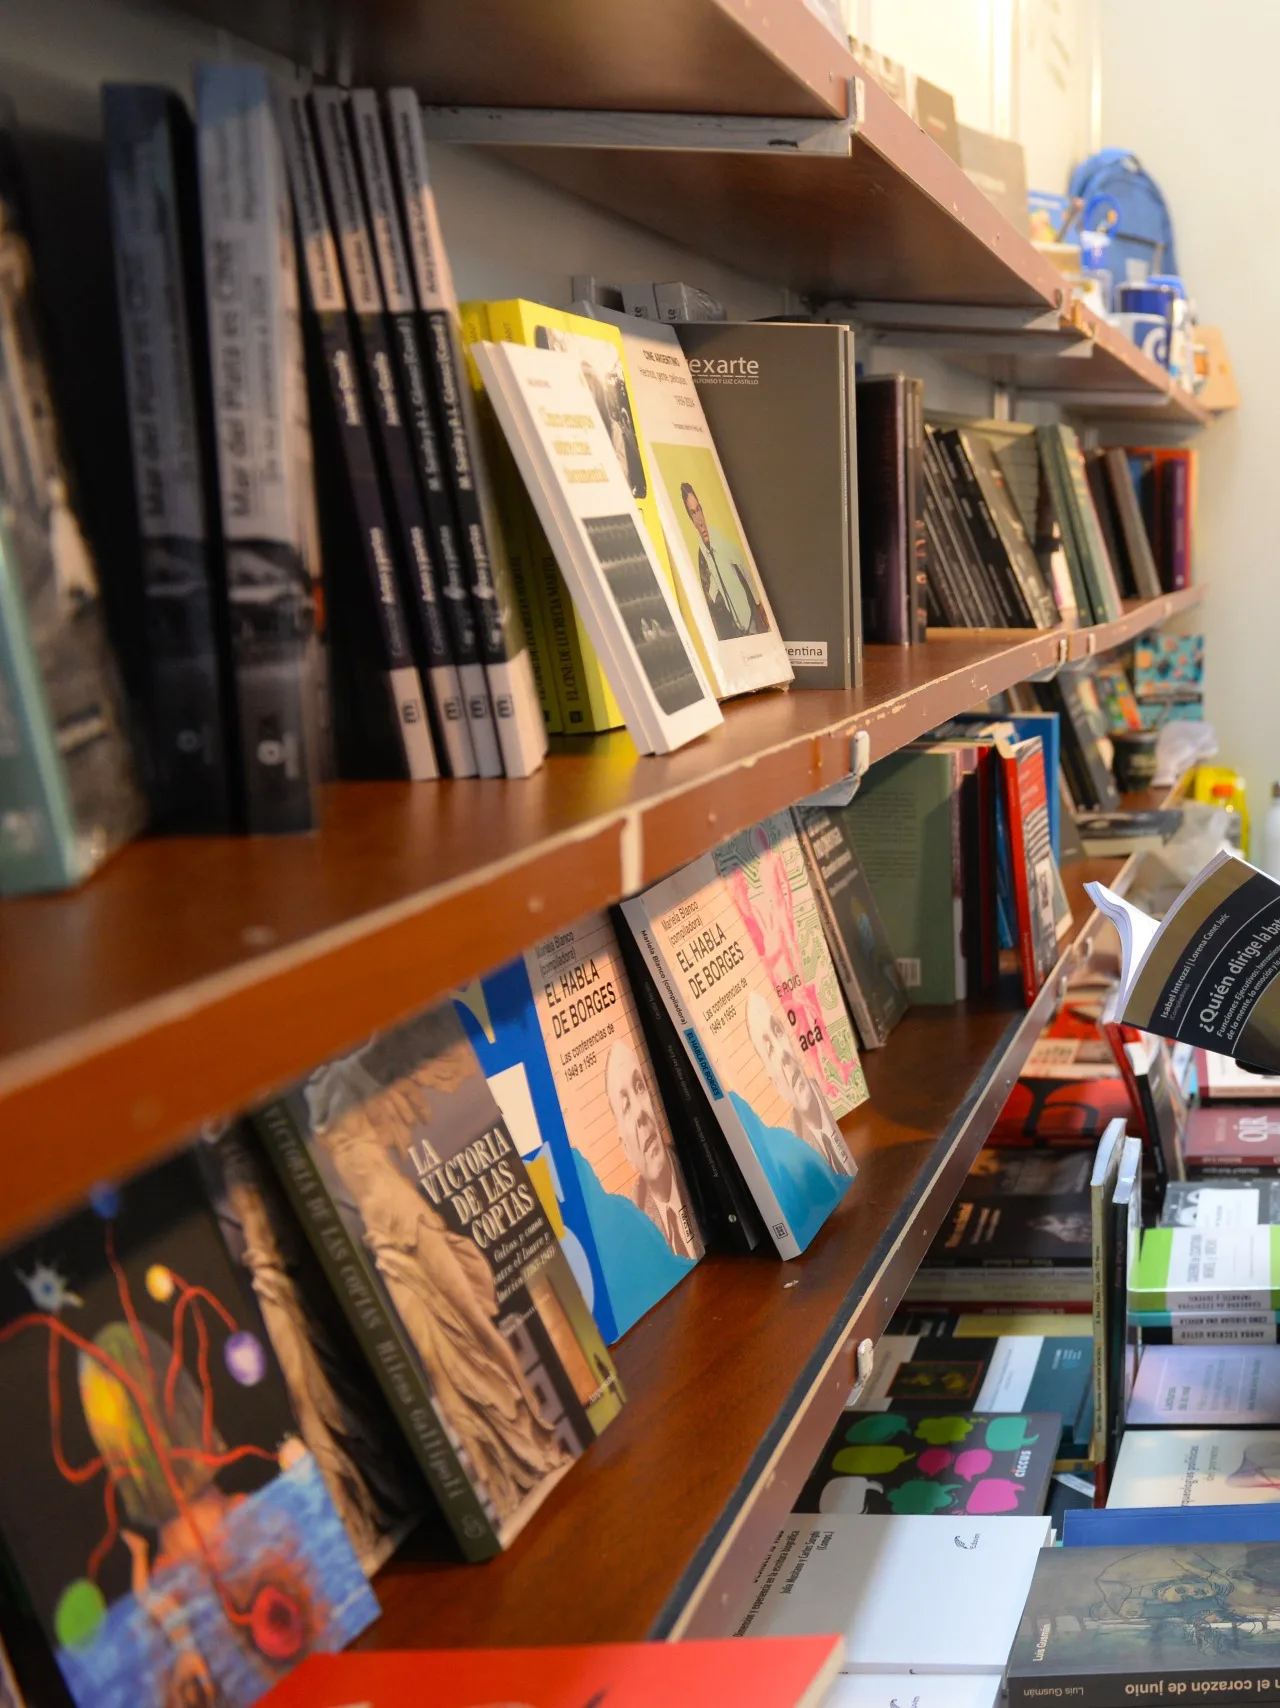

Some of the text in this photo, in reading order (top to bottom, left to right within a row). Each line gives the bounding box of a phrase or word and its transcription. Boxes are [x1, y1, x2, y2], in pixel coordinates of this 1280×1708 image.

[643, 349, 681, 367] CINE ARGENTINO
[689, 356, 759, 374] exarte
[785, 646, 823, 657] entina
[661, 901, 699, 931] Mariela Blanco
[669, 916, 704, 948] (compiladora)
[675, 923, 727, 973] EL HABLA
[688, 941, 745, 999] DE BORGES
[1160, 913, 1230, 1018] Isabel Introzzi Lorena Canet Juric
[544, 959, 600, 1008] EL HABLA
[641, 930, 687, 1026] Mariela Blanco (compiladora)
[703, 977, 748, 1022] Las conferencias de
[782, 975, 801, 995] ROIG
[1199, 973, 1236, 1033] ¿Quién
[1228, 938, 1261, 975] dirige
[1257, 929, 1271, 944] la
[551, 981, 616, 1039] DE BORGES
[1216, 999, 1239, 1037] Funciones
[1234, 970, 1261, 1002] Ejecutivas:
[1226, 1029, 1235, 1040] de
[1231, 1018, 1239, 1028] la
[1236, 999, 1252, 1021] mente,
[1248, 989, 1257, 1001] la
[1253, 966, 1274, 991] emoción
[560, 1022, 615, 1066] Las conferencias de
[799, 1019, 824, 1052] acá
[687, 1032, 720, 1097] EL HABLA DE BORGES
[408, 1139, 442, 1176] LA
[420, 1127, 513, 1205] VICTORIA
[451, 1161, 516, 1226] DE LAS
[471, 1183, 536, 1249] COPIAS
[319, 1219, 348, 1261] LAS
[339, 1263, 384, 1330] COPIAS
[409, 1408, 465, 1500] Gallipoli
[732, 1611, 752, 1637] Dimensión
[752, 1580, 772, 1611] experiencia
[774, 1551, 788, 1572] escritura
[783, 1530, 800, 1554] biográfica
[780, 1580, 792, 1594] Julia
[1032, 1624, 1051, 1662] Luis Gusmán
[1023, 1686, 1084, 1697] Luis Gusmán
[1124, 1680, 1163, 1696] junio
[1167, 1680, 1188, 1694] de
[1191, 1679, 1253, 1694] corazón
[1257, 1678, 1271, 1692] el
